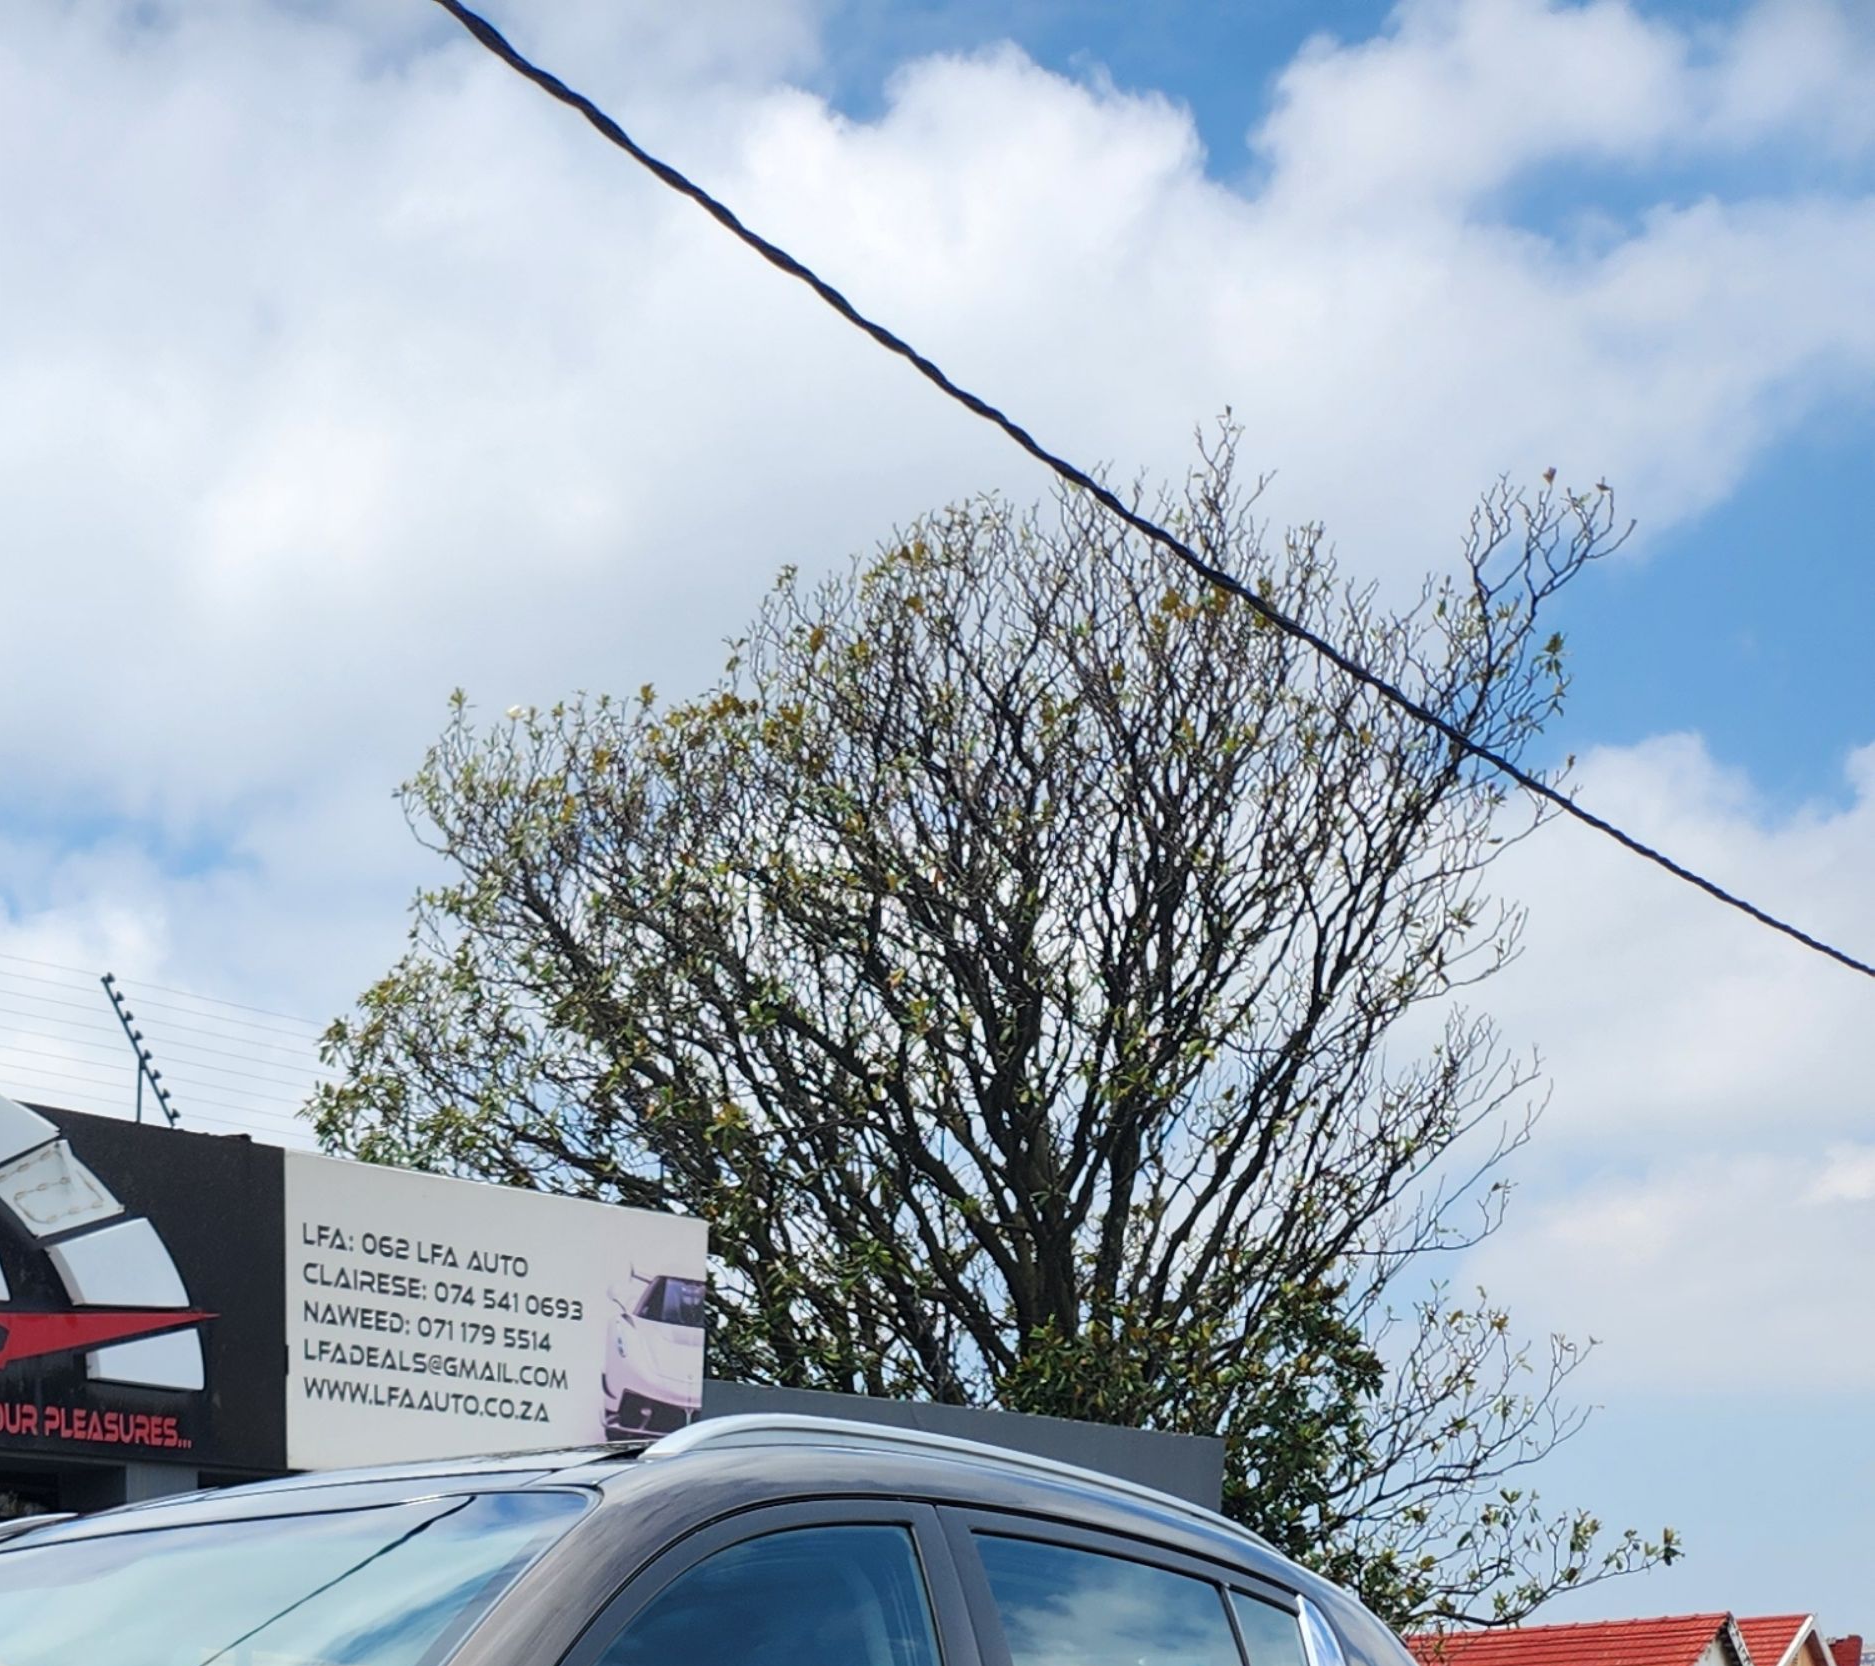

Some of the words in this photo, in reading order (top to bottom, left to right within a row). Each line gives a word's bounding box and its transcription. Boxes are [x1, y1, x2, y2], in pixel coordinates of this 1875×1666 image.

[302, 1222, 355, 1252] LFA:
[361, 1232, 410, 1261] 062
[417, 1241, 459, 1269] LFA
[466, 1250, 529, 1278] AUTO
[303, 1262, 427, 1301] CLAIRESE:
[434, 1281, 476, 1307] 074
[483, 1288, 519, 1313] 541
[525, 1294, 583, 1321] 0693
[303, 1300, 411, 1335] NAWEED:
[417, 1316, 454, 1341] 071
[460, 1321, 496, 1346] 179
[503, 1327, 552, 1353] 5514
[304, 1338, 568, 1390] LFADEALS@GMAIL.COM
[303, 1376, 550, 1424] WWW.LFAAUTO.CO.ZA
[45, 1407, 193, 1450] PLEASURES...
